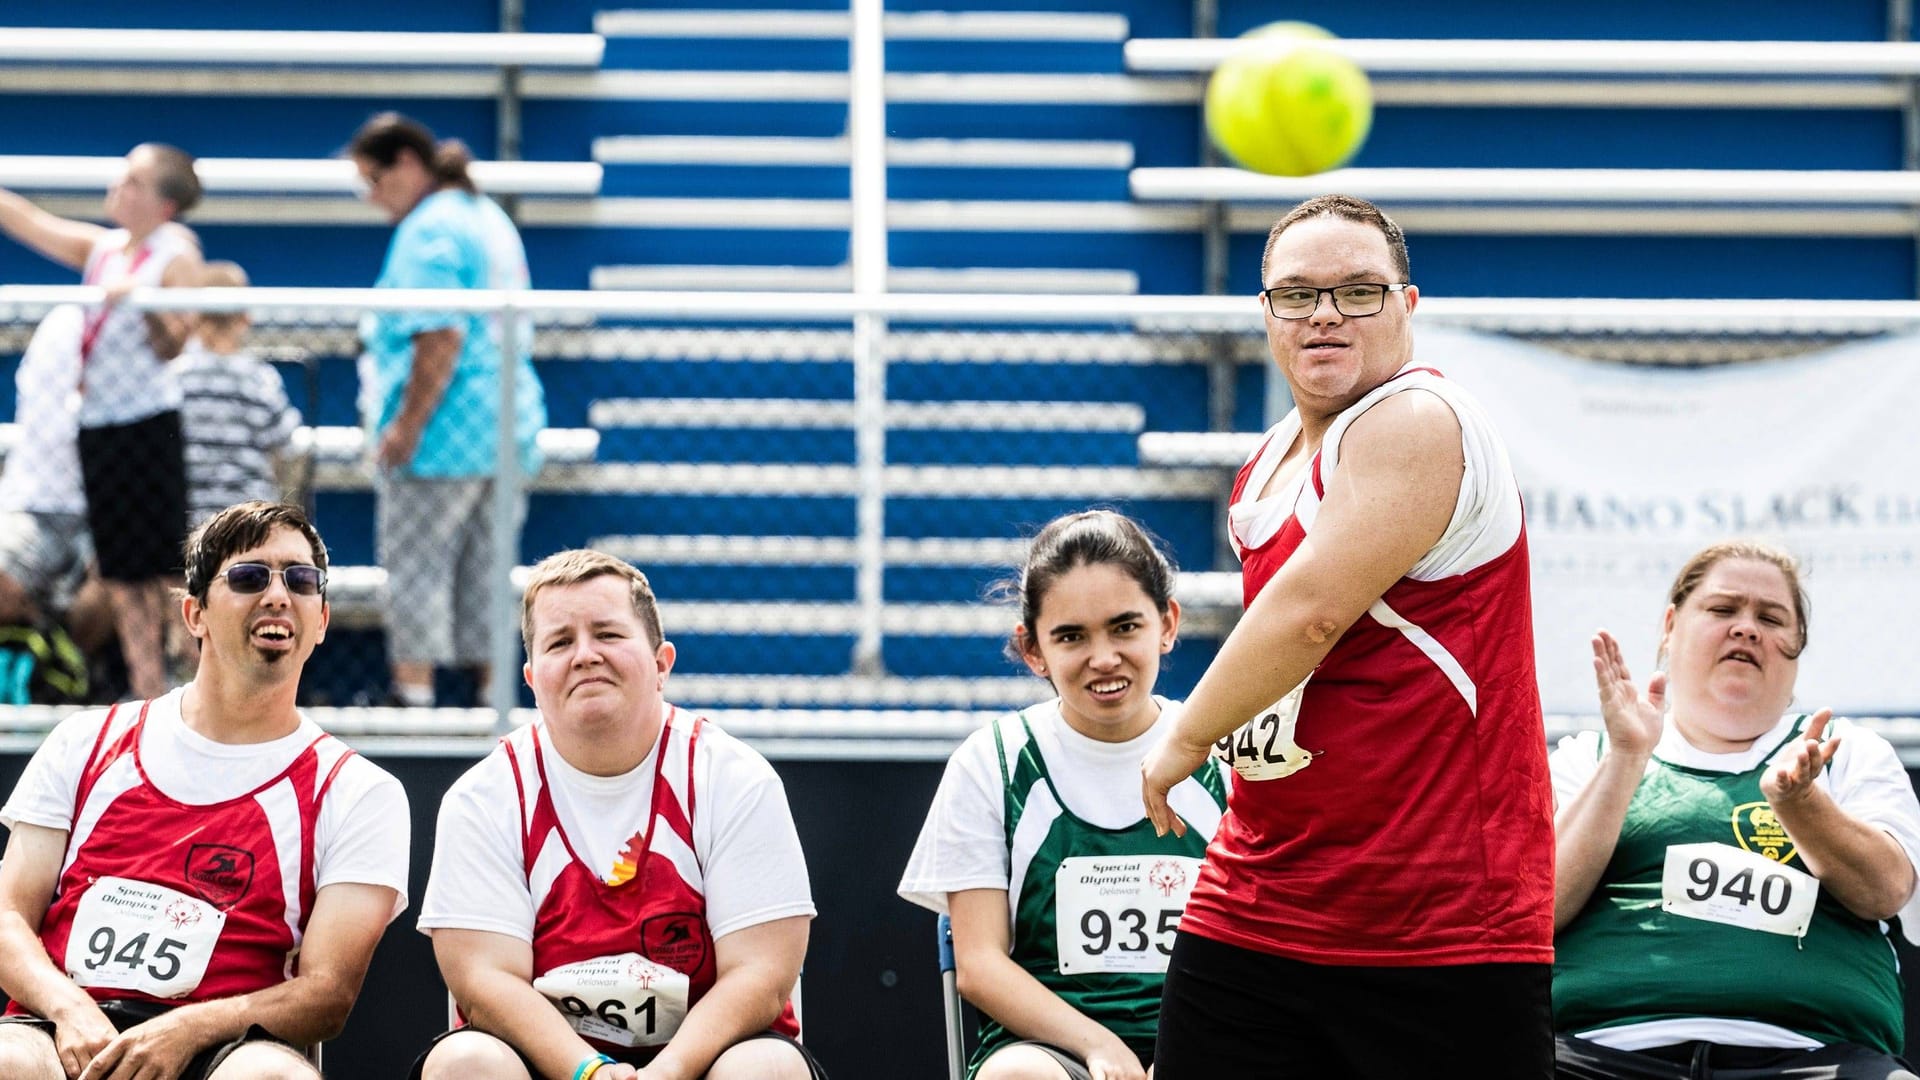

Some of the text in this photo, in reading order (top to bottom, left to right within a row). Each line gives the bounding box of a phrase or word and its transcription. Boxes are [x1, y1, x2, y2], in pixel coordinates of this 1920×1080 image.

[1695, 480, 1863, 531] SLACK
[1215, 713, 1287, 768] 942
[1080, 875, 1141, 886] Olympics
[1092, 863, 1141, 874] Special
[118, 886, 163, 901] Special
[1100, 887, 1141, 896] Delaware
[1686, 857, 1792, 916] 940
[102, 894, 158, 911] Olympics
[1080, 908, 1184, 956] 935
[84, 926, 188, 981] 945
[577, 977, 619, 987] Delaware
[560, 996, 656, 1036] 961
